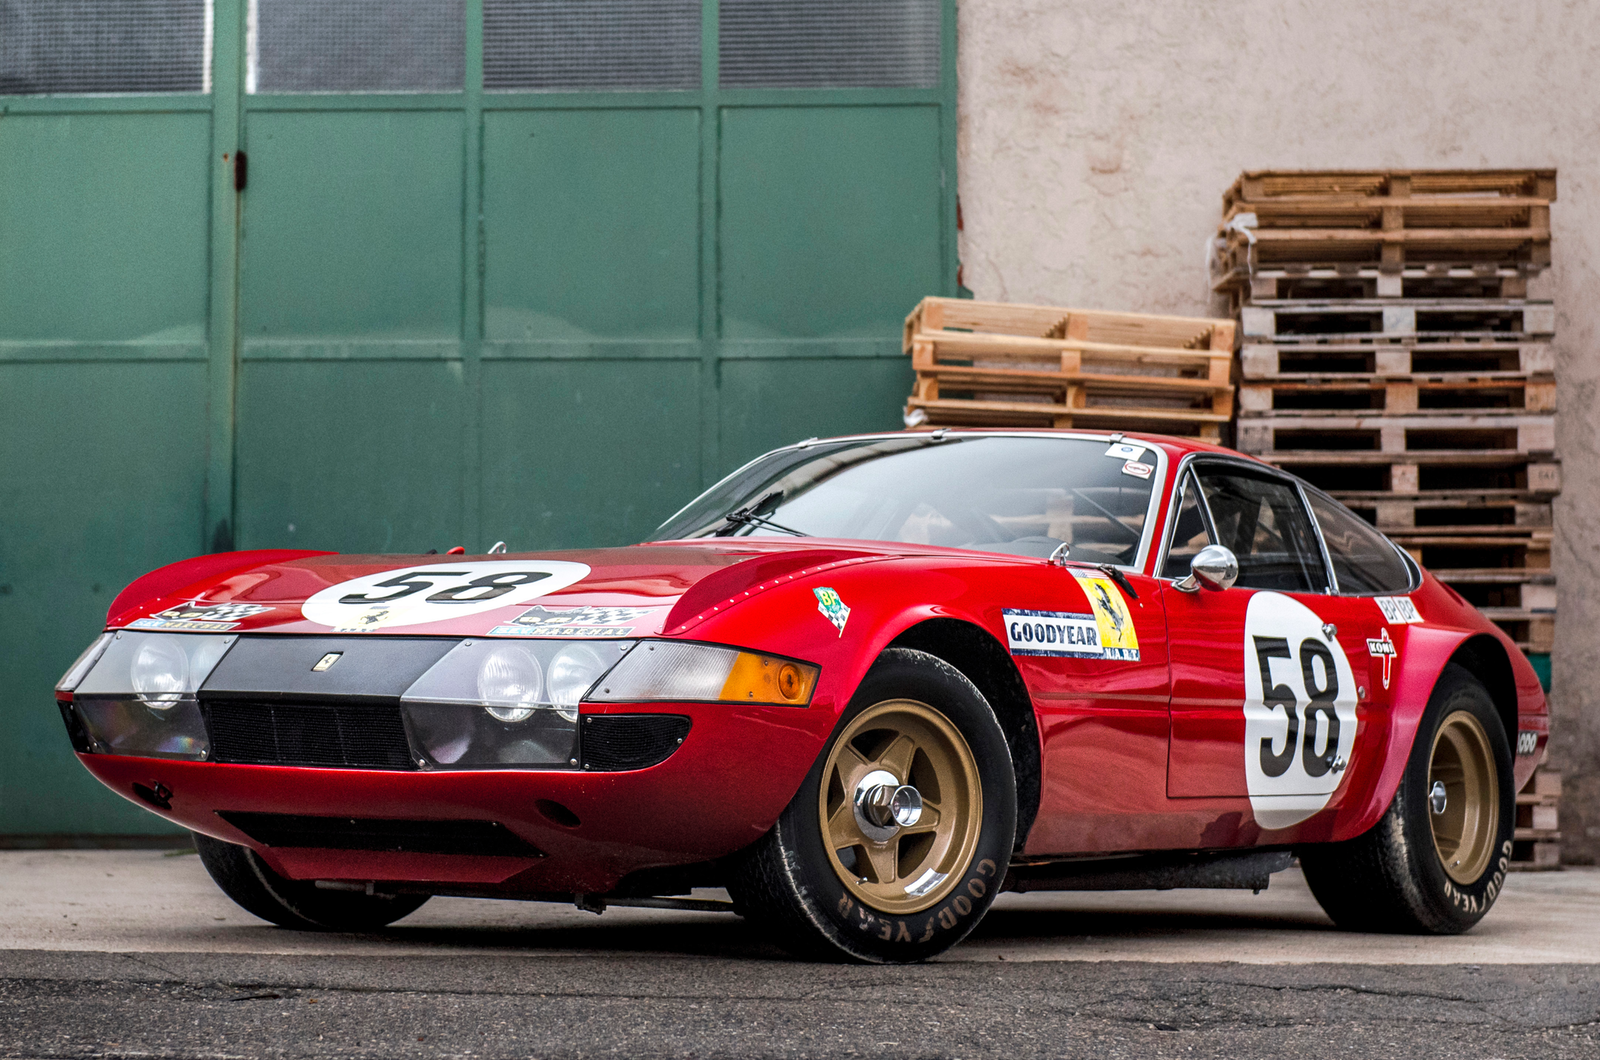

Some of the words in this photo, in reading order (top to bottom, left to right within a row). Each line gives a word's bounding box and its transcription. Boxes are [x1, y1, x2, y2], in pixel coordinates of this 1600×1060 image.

[339, 571, 553, 604] 58
[819, 591, 837, 606] BP
[1379, 600, 1398, 620] BP
[1398, 600, 1416, 620] BP
[163, 621, 229, 630] MARCHAL
[532, 627, 626, 635] MARCHAL
[1010, 622, 1097, 646] GOODYEAR
[1369, 642, 1393, 653] KONI
[1252, 634, 1340, 777] 58
